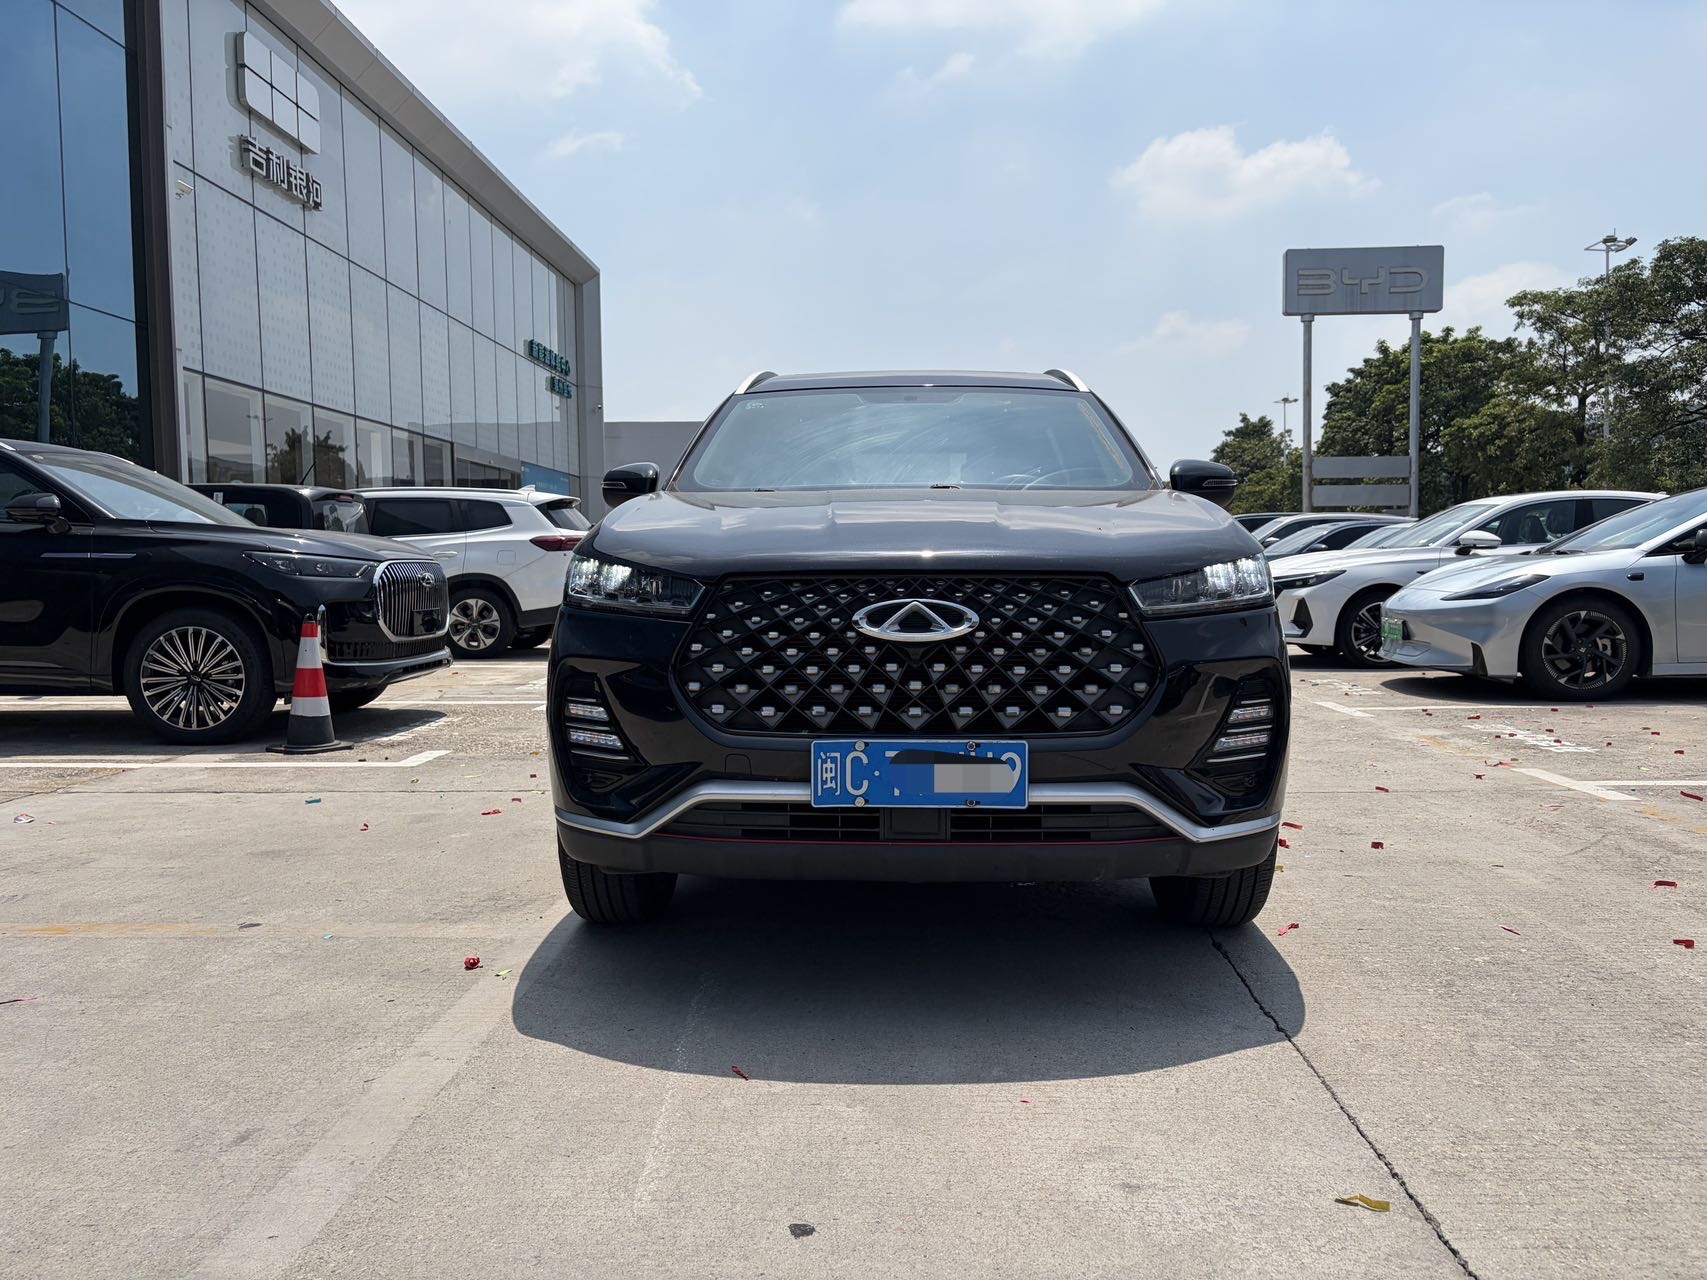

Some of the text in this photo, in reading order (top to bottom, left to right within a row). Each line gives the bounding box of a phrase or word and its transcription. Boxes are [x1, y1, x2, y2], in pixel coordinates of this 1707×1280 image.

[247, 135, 324, 211] 吉利银河
[1297, 266, 1429, 295] BYD
